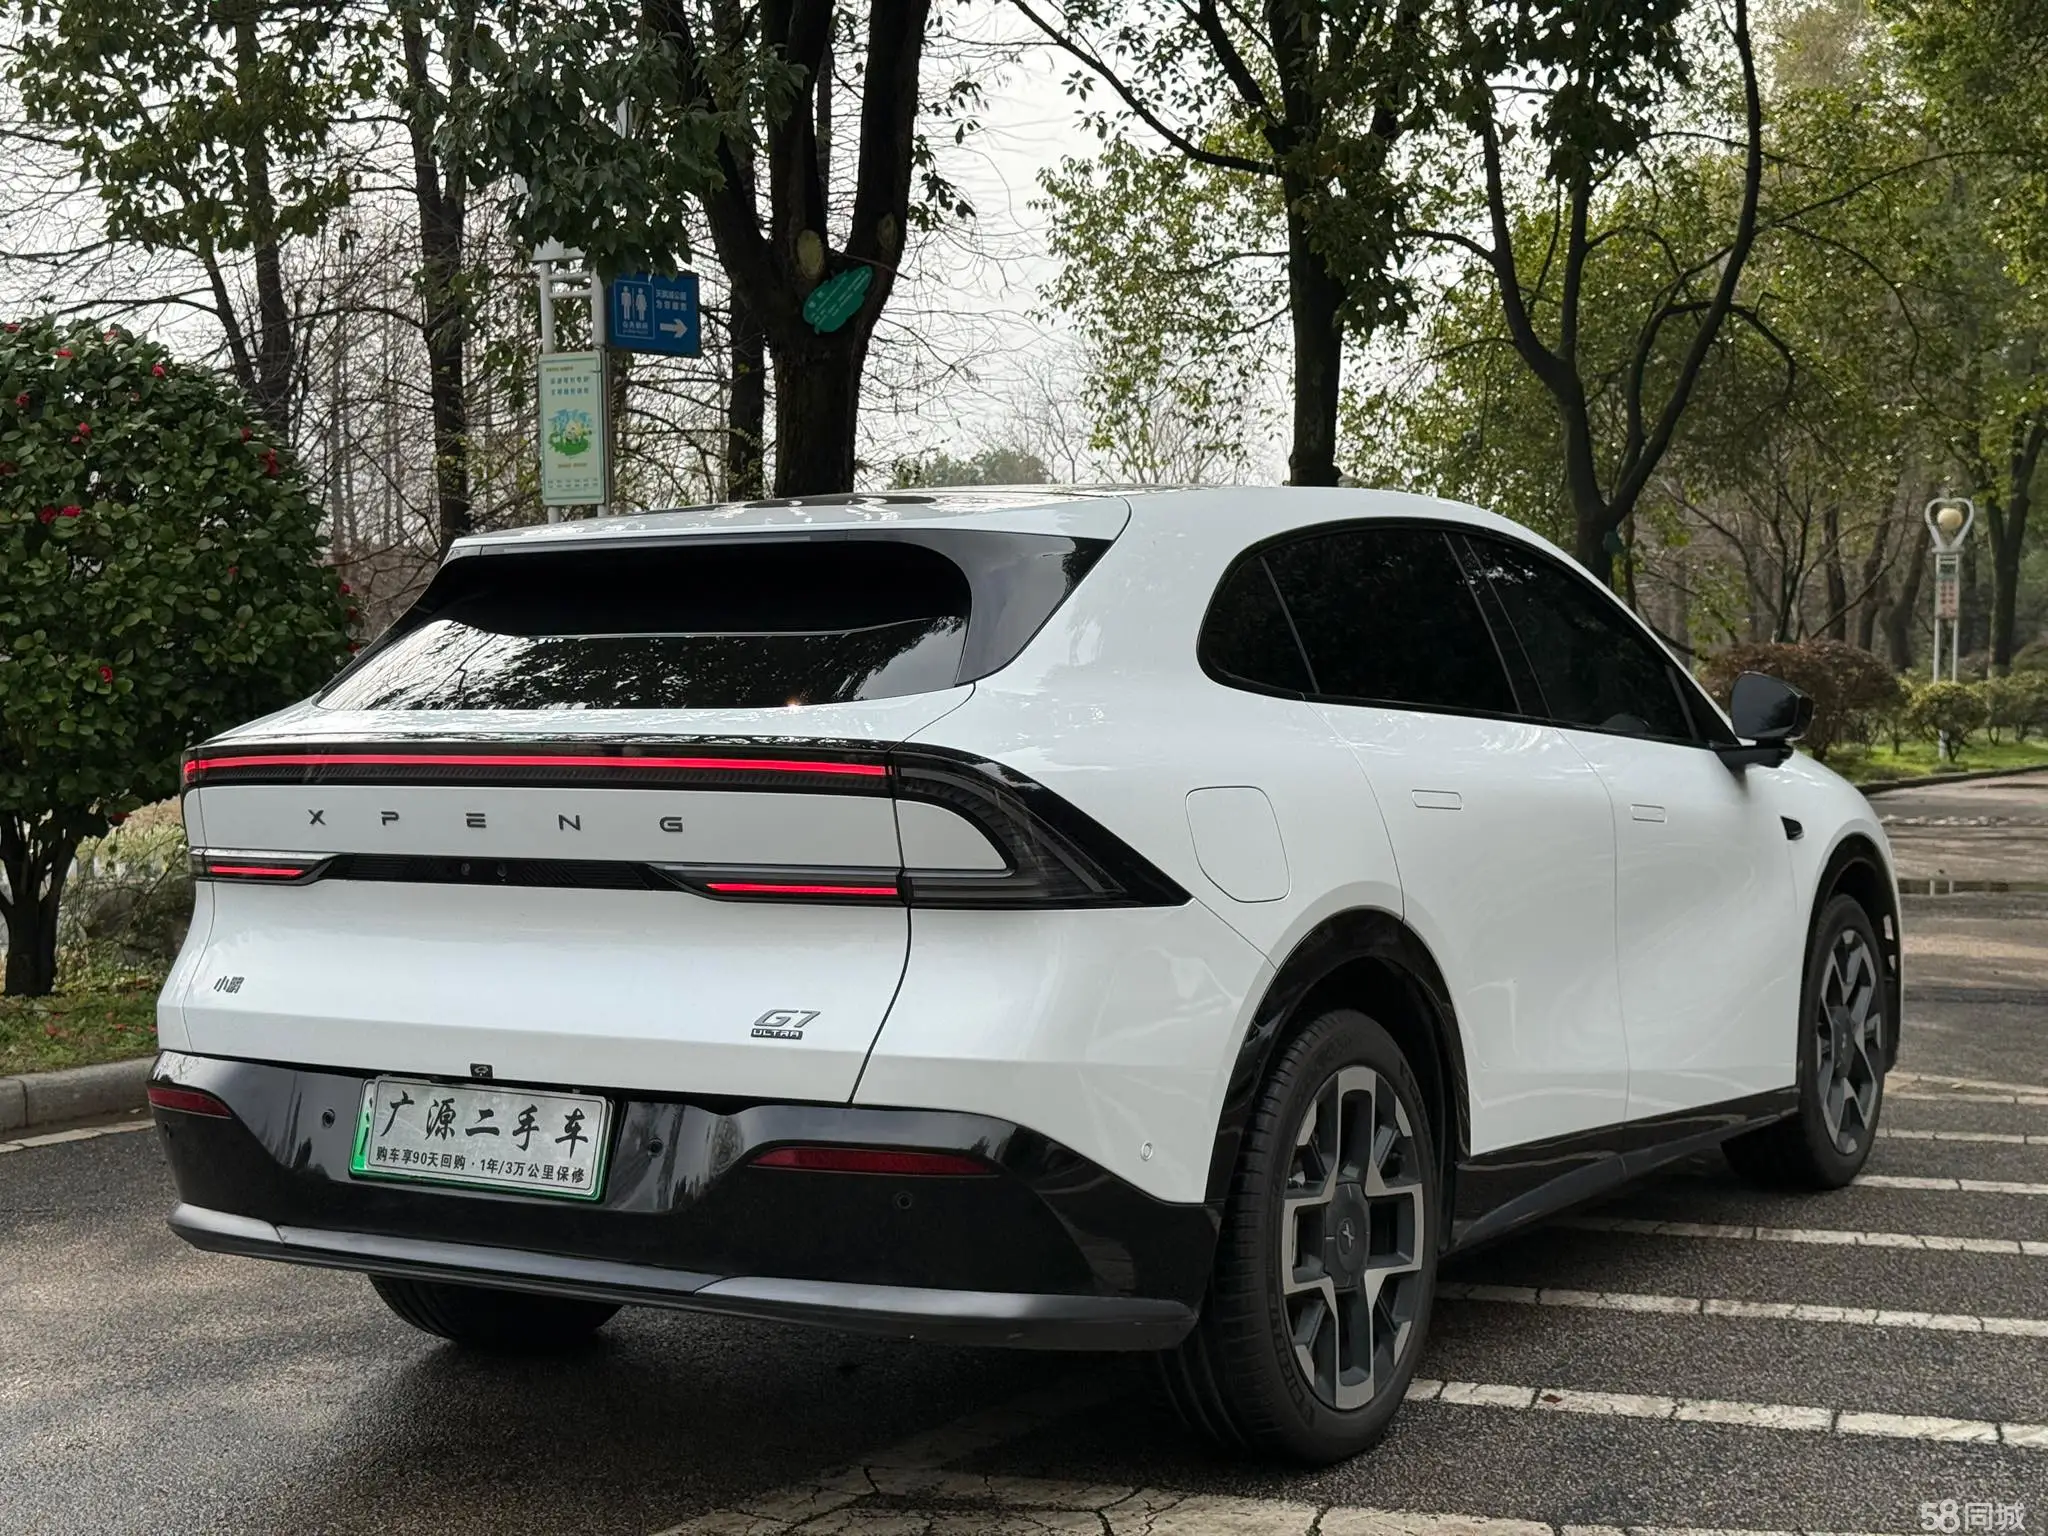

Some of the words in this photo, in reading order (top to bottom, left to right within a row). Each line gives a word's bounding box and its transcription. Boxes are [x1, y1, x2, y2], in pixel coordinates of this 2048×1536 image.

[307, 809, 684, 833] XPENG
[213, 975, 245, 994] 小鹏
[753, 1008, 821, 1028] G7
[752, 1028, 801, 1039] ULTRA
[379, 1090, 590, 1159] 广源二手车
